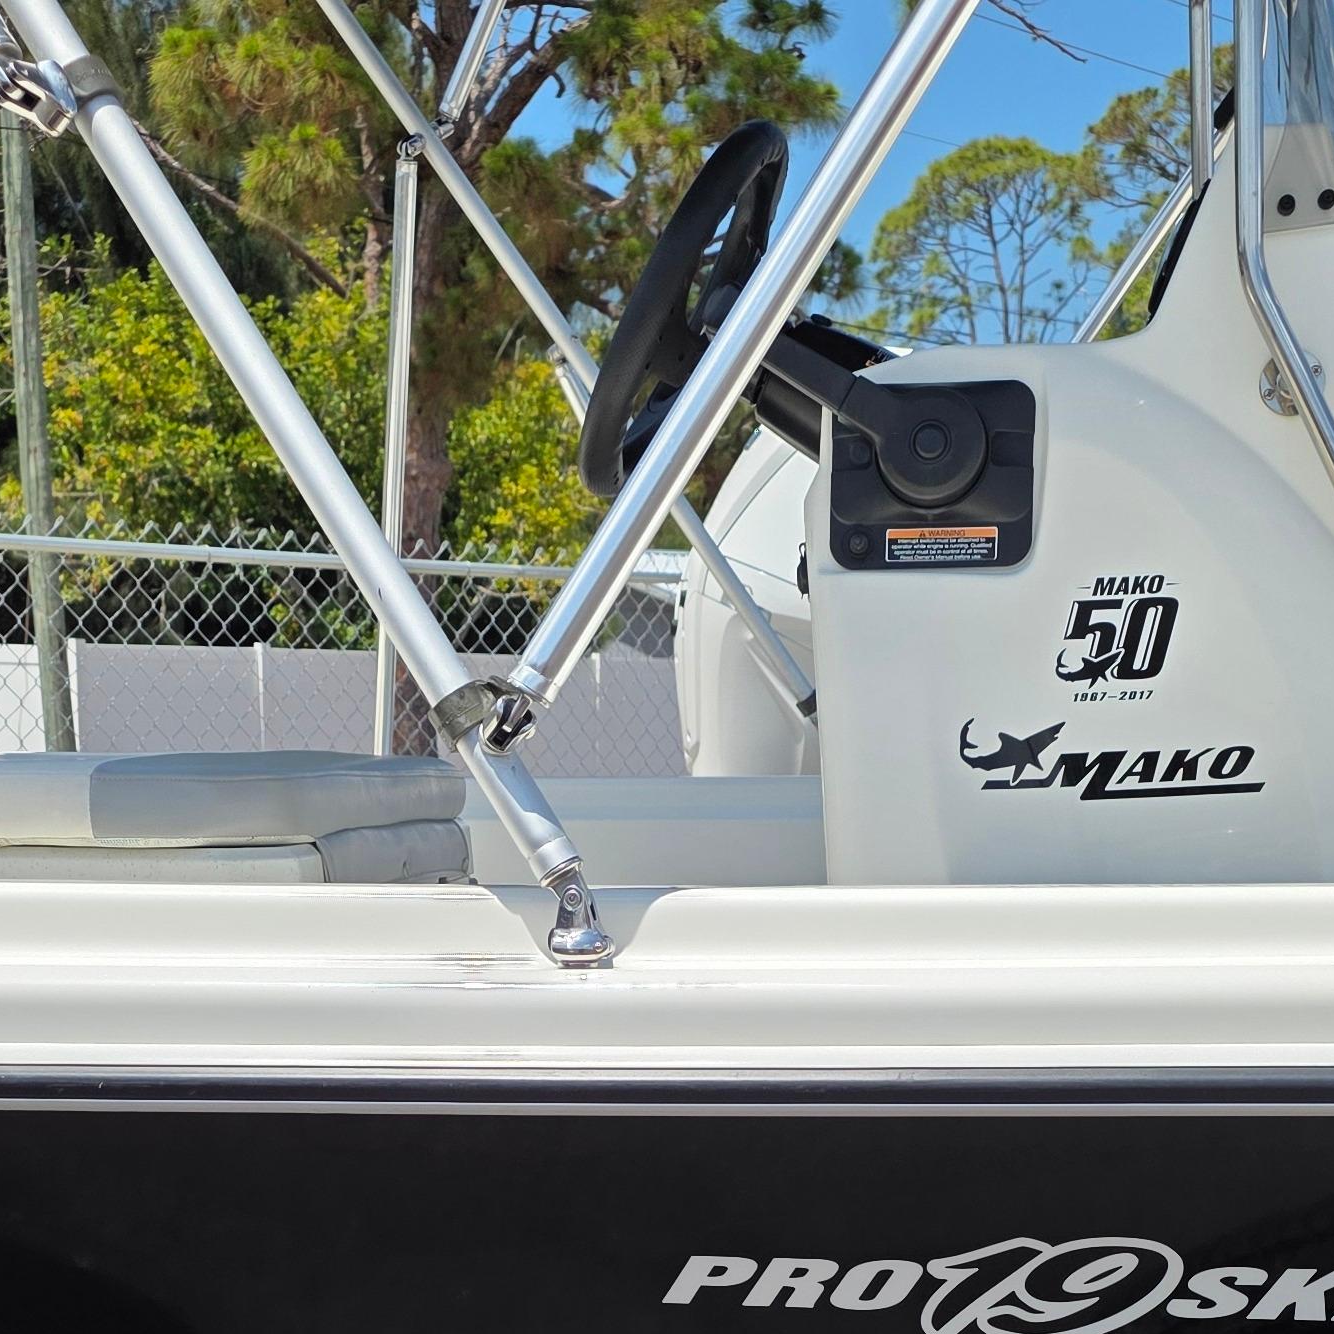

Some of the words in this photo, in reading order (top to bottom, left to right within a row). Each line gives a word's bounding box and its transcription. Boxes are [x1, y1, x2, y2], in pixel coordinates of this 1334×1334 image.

[928, 529, 966, 537] WARNING
[1092, 574, 1165, 597] MAKO
[1063, 596, 1180, 680] 50
[1053, 744, 1265, 801] MAKO
[661, 1255, 927, 1311] PRO
